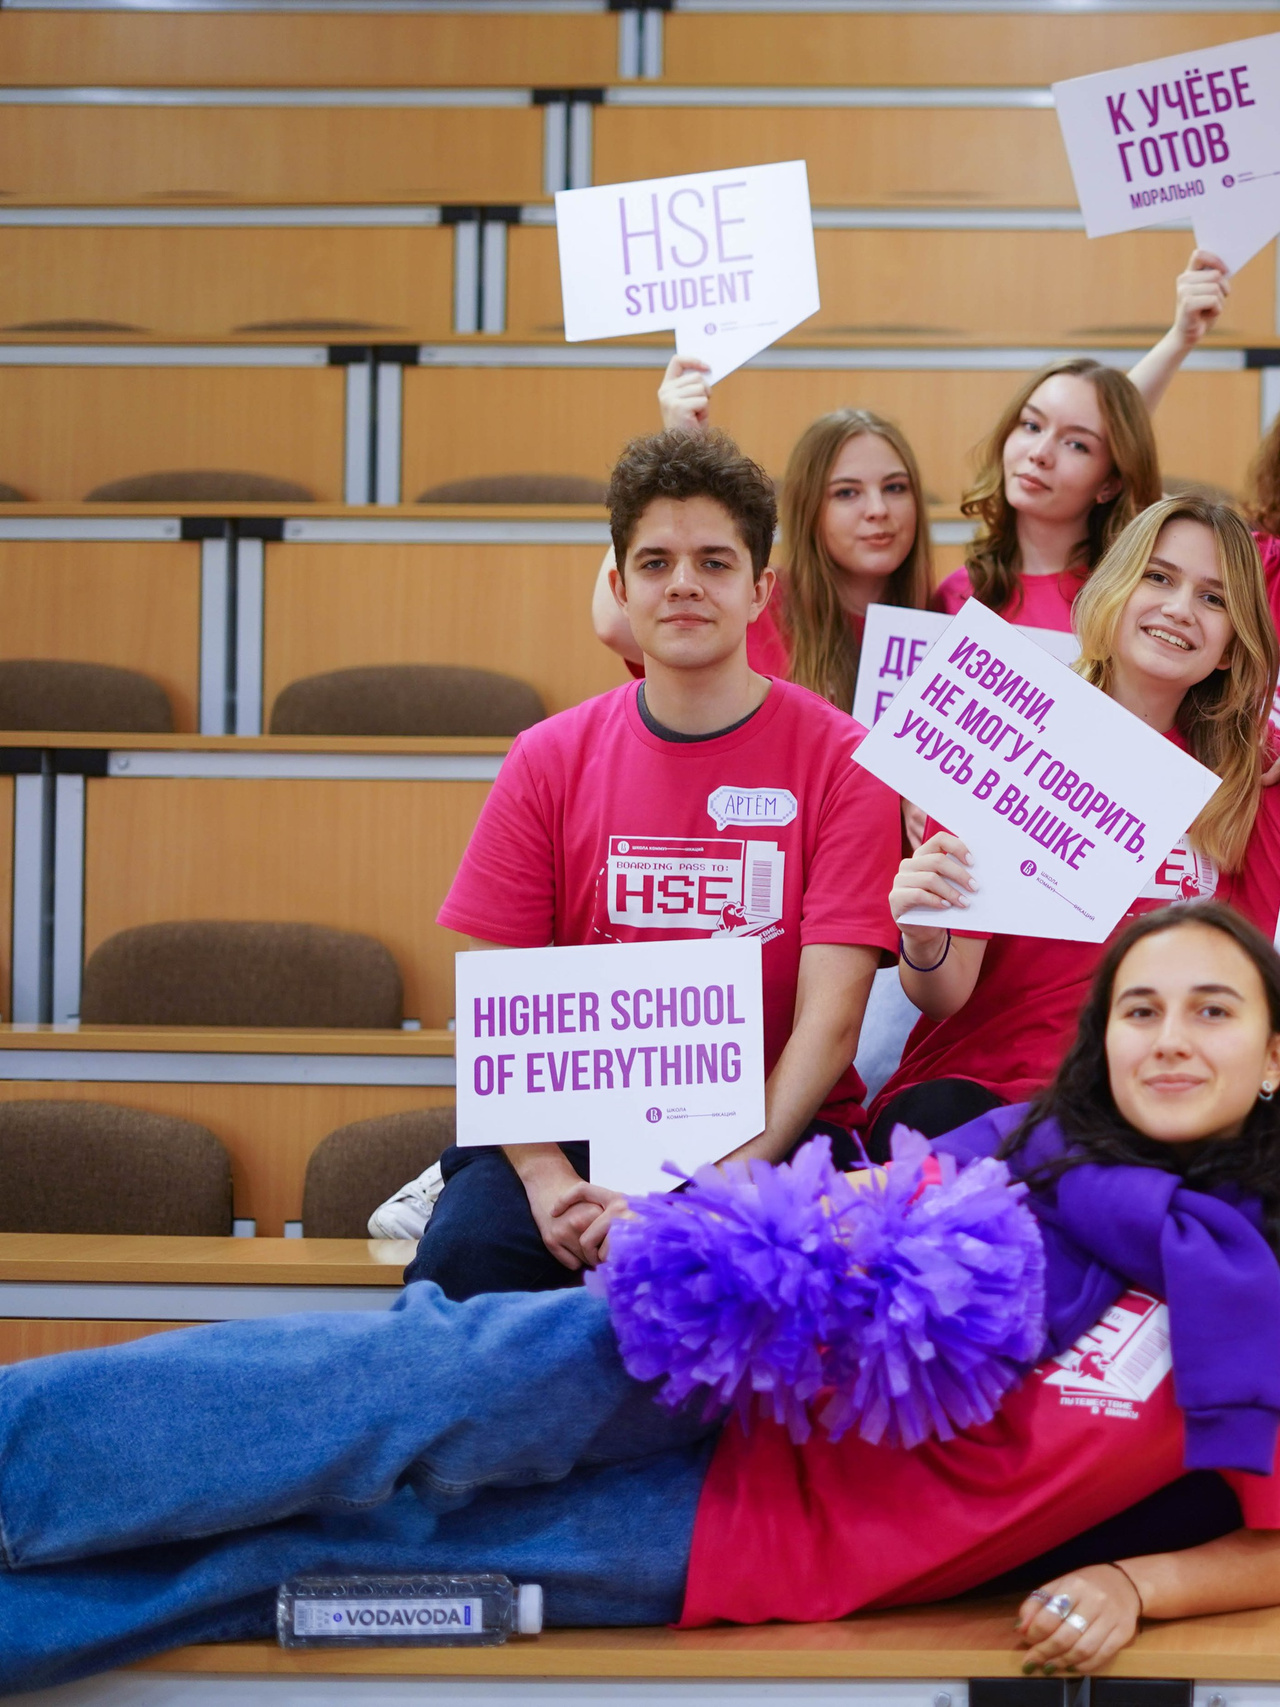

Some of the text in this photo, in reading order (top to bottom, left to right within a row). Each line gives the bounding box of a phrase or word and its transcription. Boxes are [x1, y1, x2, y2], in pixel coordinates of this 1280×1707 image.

[1106, 65, 1255, 135] К УЧЁБЕ
[1118, 122, 1229, 182] ГОТОВ
[1130, 179, 1205, 209] МОРАЛЬНО
[619, 181, 753, 275] HSE
[625, 270, 753, 315] STUDENT
[948, 636, 1055, 734] ИЗВИНИ,
[893, 709, 975, 786] УЧУСЬ
[972, 768, 1002, 800] В
[992, 784, 1096, 870] ВЫШКЕ
[920, 673, 965, 717] НЕ
[955, 698, 1034, 764] МОГУ
[1023, 749, 1148, 863] ГОВОРИТЬ,
[724, 794, 777, 816] АРТЁМ
[616, 861, 729, 873] BOARDING PASS TO:
[616, 874, 733, 915] HSE
[474, 984, 745, 1038] HIGHER SCHOOL
[474, 1042, 742, 1096] OF EVERYTHING
[346, 1609, 462, 1626] VODAVODA
